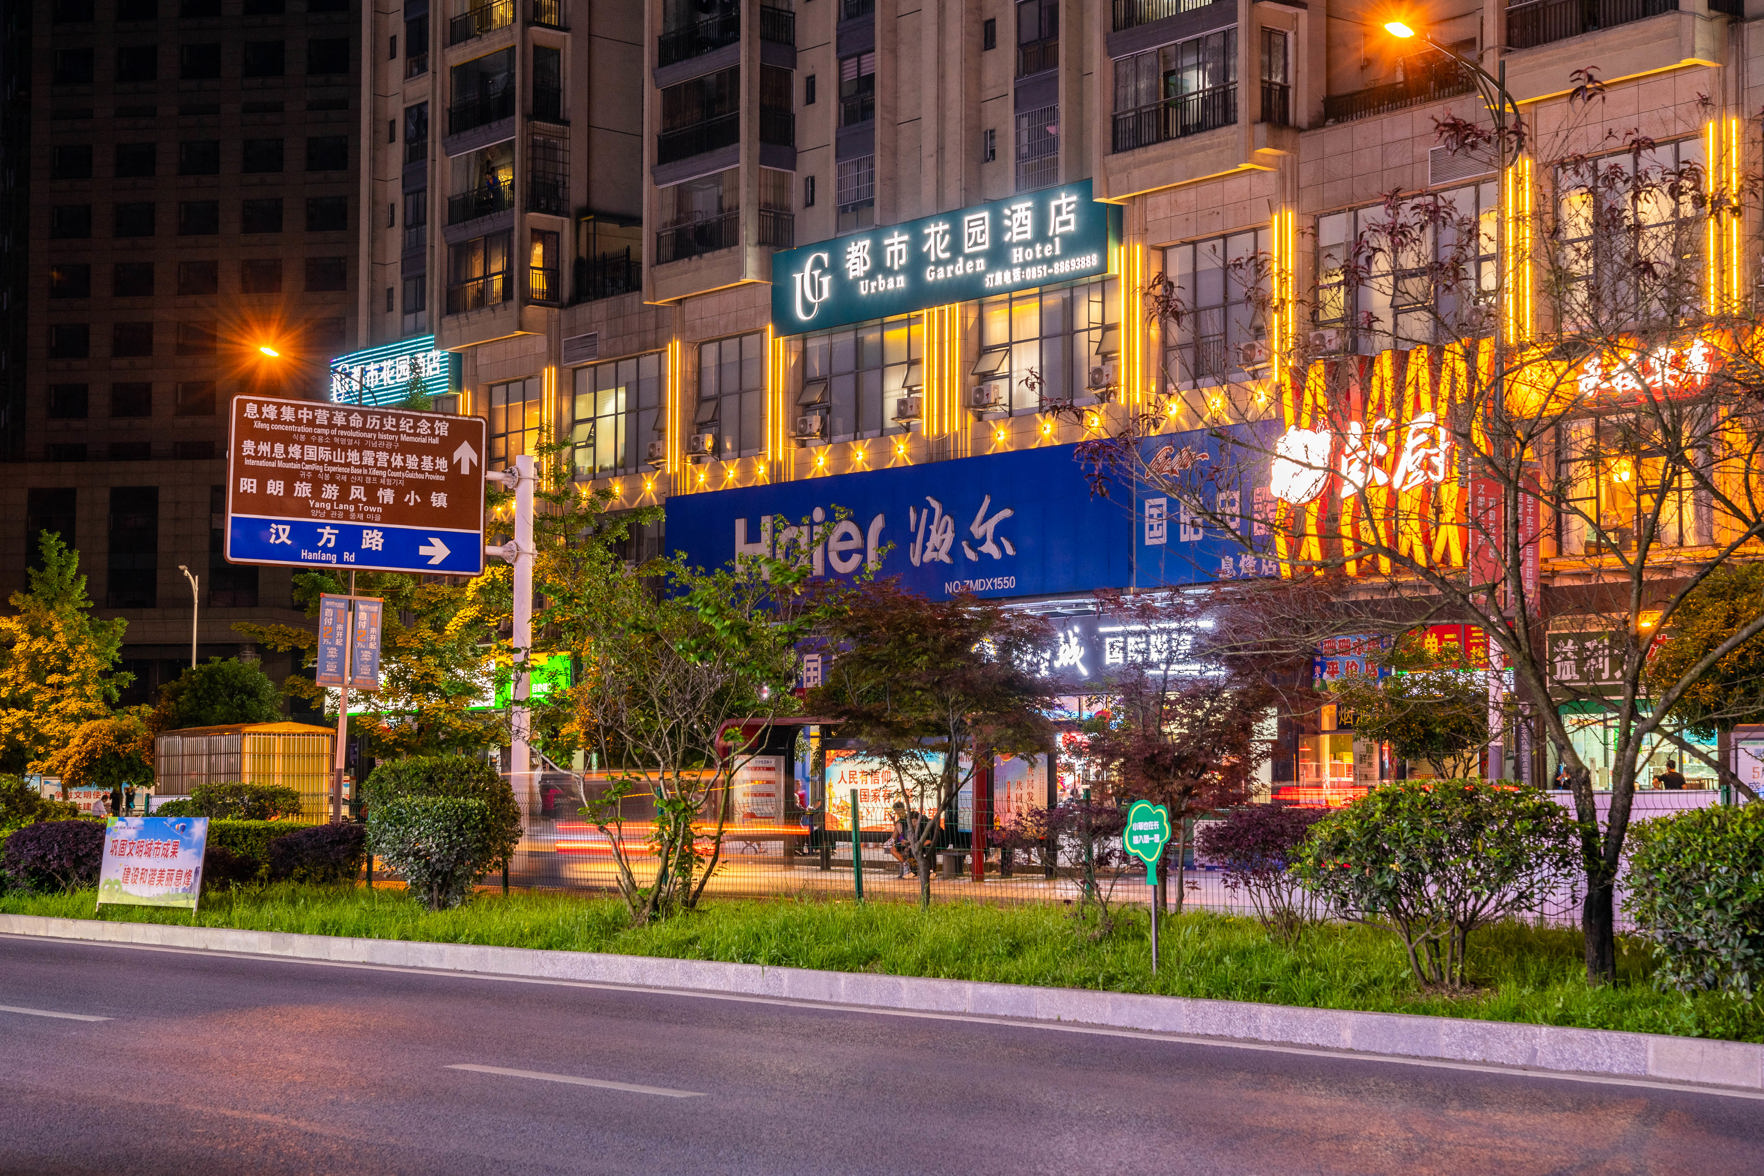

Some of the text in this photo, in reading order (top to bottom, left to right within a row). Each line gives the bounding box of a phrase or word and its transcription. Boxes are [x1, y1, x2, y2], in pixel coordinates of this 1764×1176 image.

[845, 191, 1078, 280] 都市花园酒店
[859, 236, 1062, 295] Urban Garden Hotel
[243, 402, 449, 437] 息烽集中营革命历史纪念馆
[253, 420, 270, 431] Xifeng
[270, 423, 313, 433] concentration
[313, 427, 330, 436] camp
[338, 428, 377, 440] revolutionary
[378, 431, 399, 442] history
[400, 433, 427, 444] Memorial
[427, 435, 440, 445] Hall
[241, 439, 449, 473] 贵州息烽国际山地露营体验基地
[244, 457, 277, 468] International
[277, 459, 301, 470] Mountain
[323, 463, 350, 475] Experience
[350, 466, 363, 474] Base
[368, 467, 387, 478] Xifeng
[425, 472, 446, 482] Province
[239, 477, 448, 509] 阳朗旅游风情小镇
[308, 499, 383, 513] Yang Lang Town
[269, 522, 385, 551] 汉方路
[734, 506, 886, 582] Haier
[909, 493, 1017, 568] 海尔
[301, 548, 355, 564] Hanfang Rd
[837, 769, 892, 785] 人民有信仰
[109, 838, 181, 859] 巩固文明城市成果
[121, 866, 193, 888] 建设和谐美丽息烽
